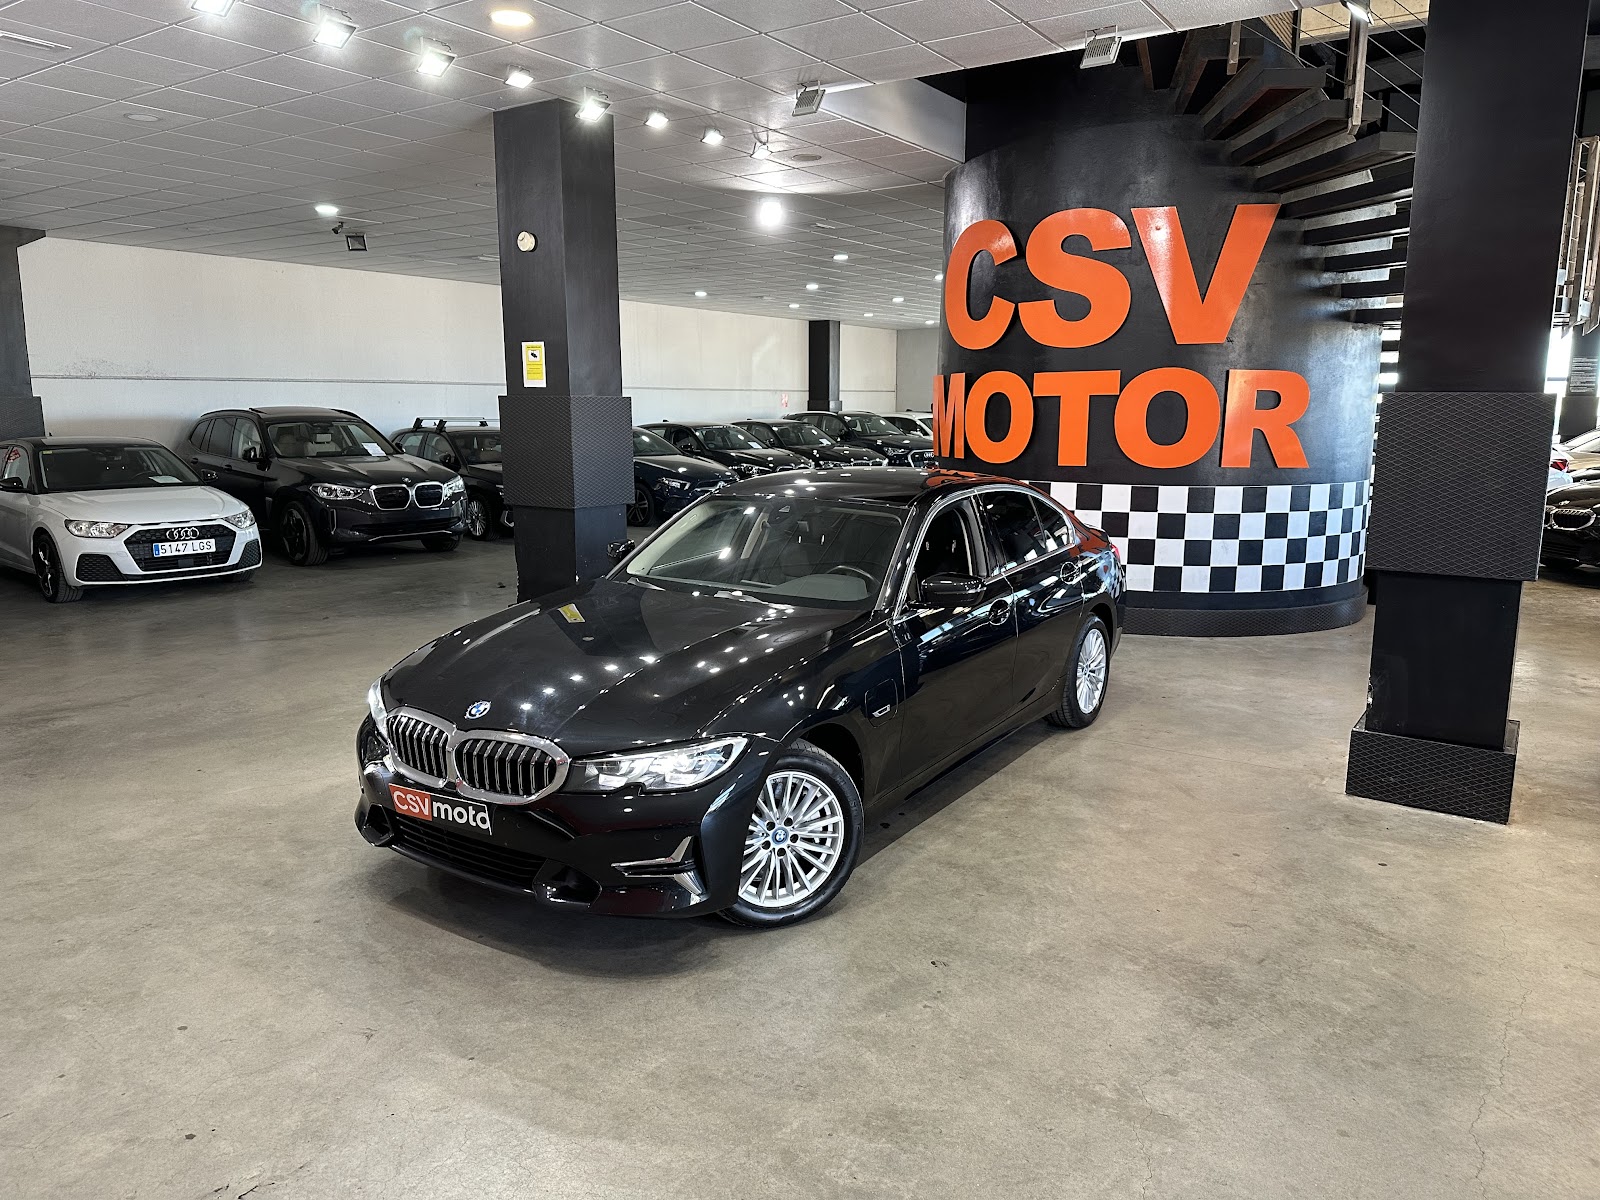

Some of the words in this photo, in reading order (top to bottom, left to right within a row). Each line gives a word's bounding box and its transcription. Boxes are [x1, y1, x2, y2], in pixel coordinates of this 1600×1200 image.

[945, 203, 1281, 349] CSV
[933, 367, 1311, 469] MOTOR
[160, 543, 188, 554] 5147
[192, 541, 212, 552] LGS
